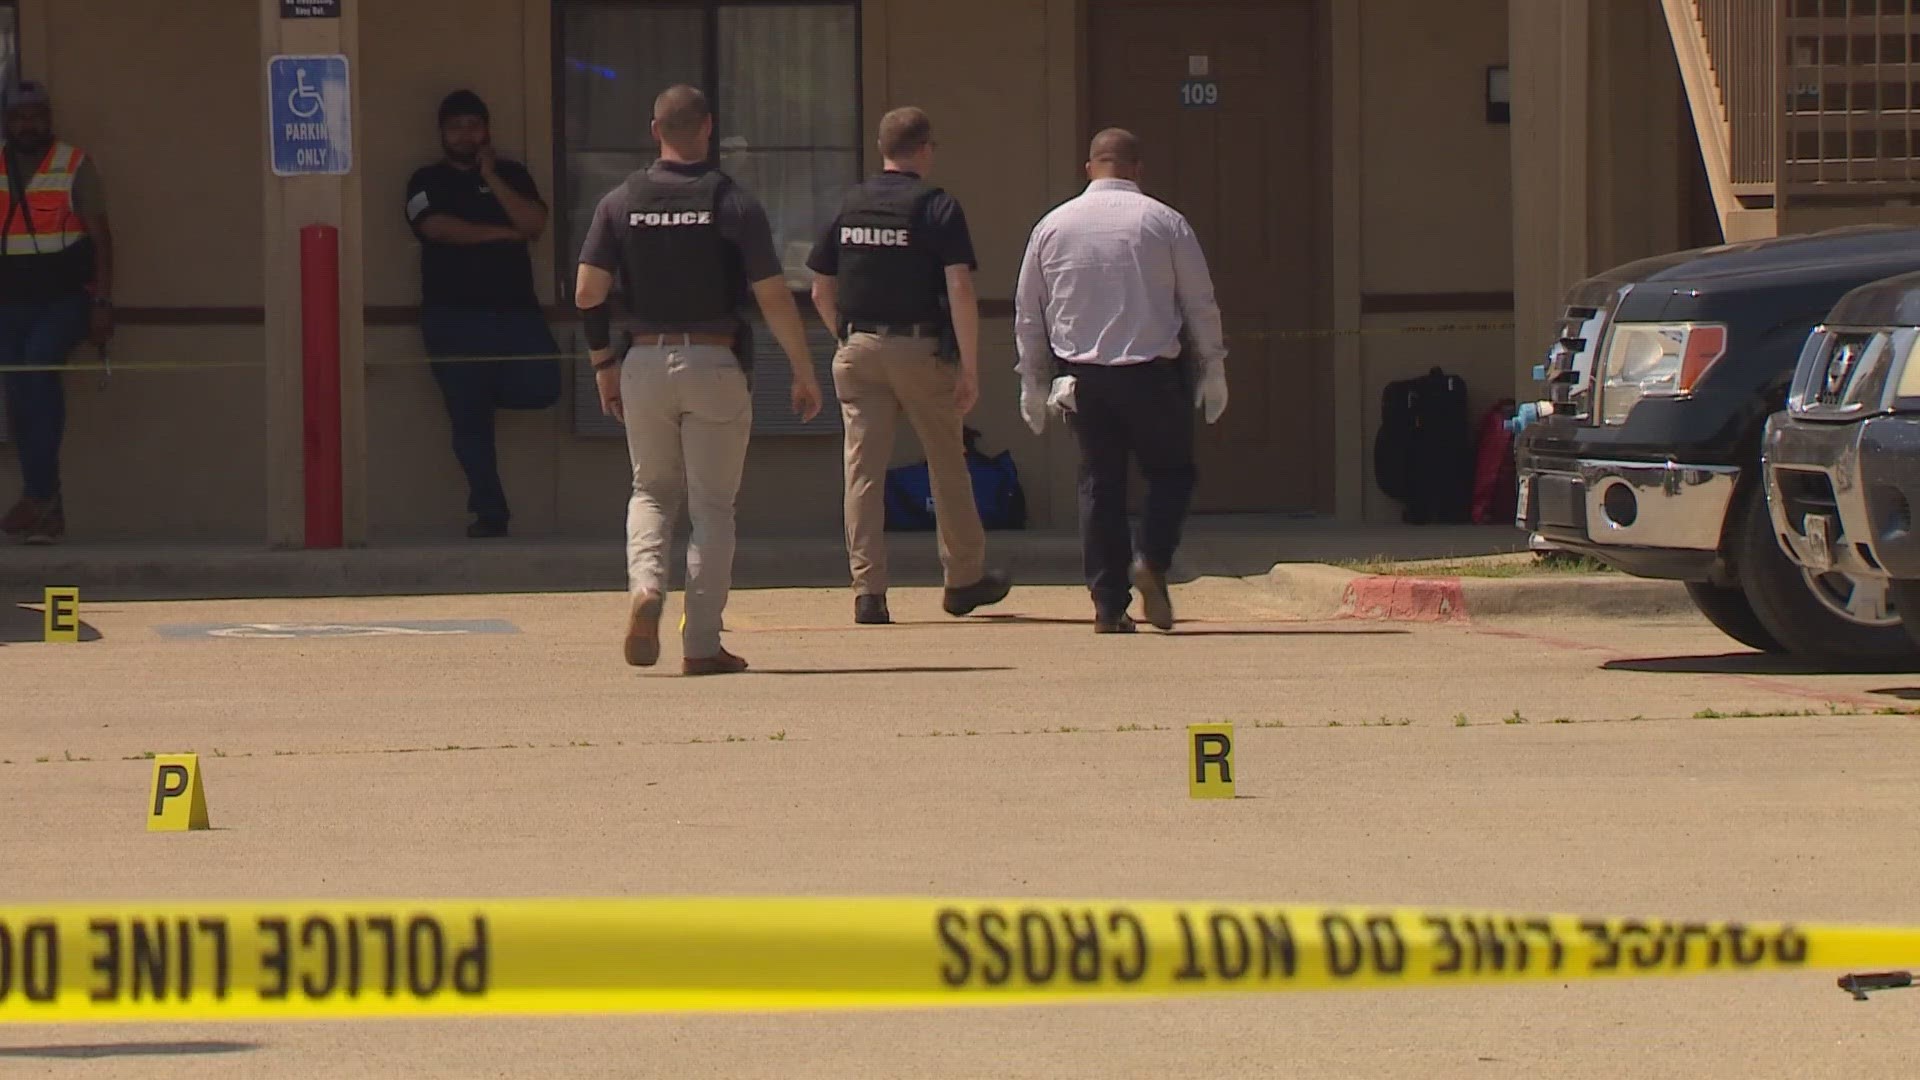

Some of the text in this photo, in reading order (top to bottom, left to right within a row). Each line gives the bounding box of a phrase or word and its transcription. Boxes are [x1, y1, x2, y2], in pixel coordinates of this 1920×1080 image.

[1182, 83, 1218, 104] 109
[285, 123, 330, 142] PARKIN
[296, 148, 327, 166] ONLY
[629, 211, 711, 227] POLICE
[840, 226, 909, 247] POLICE
[51, 595, 75, 632] E
[1194, 733, 1232, 783] R
[153, 764, 189, 816] P
[89, 917, 230, 1002] LINE
[257, 915, 489, 999] POLICE
[935, 908, 1809, 987] POLICE LINE DO NOT CROSS
